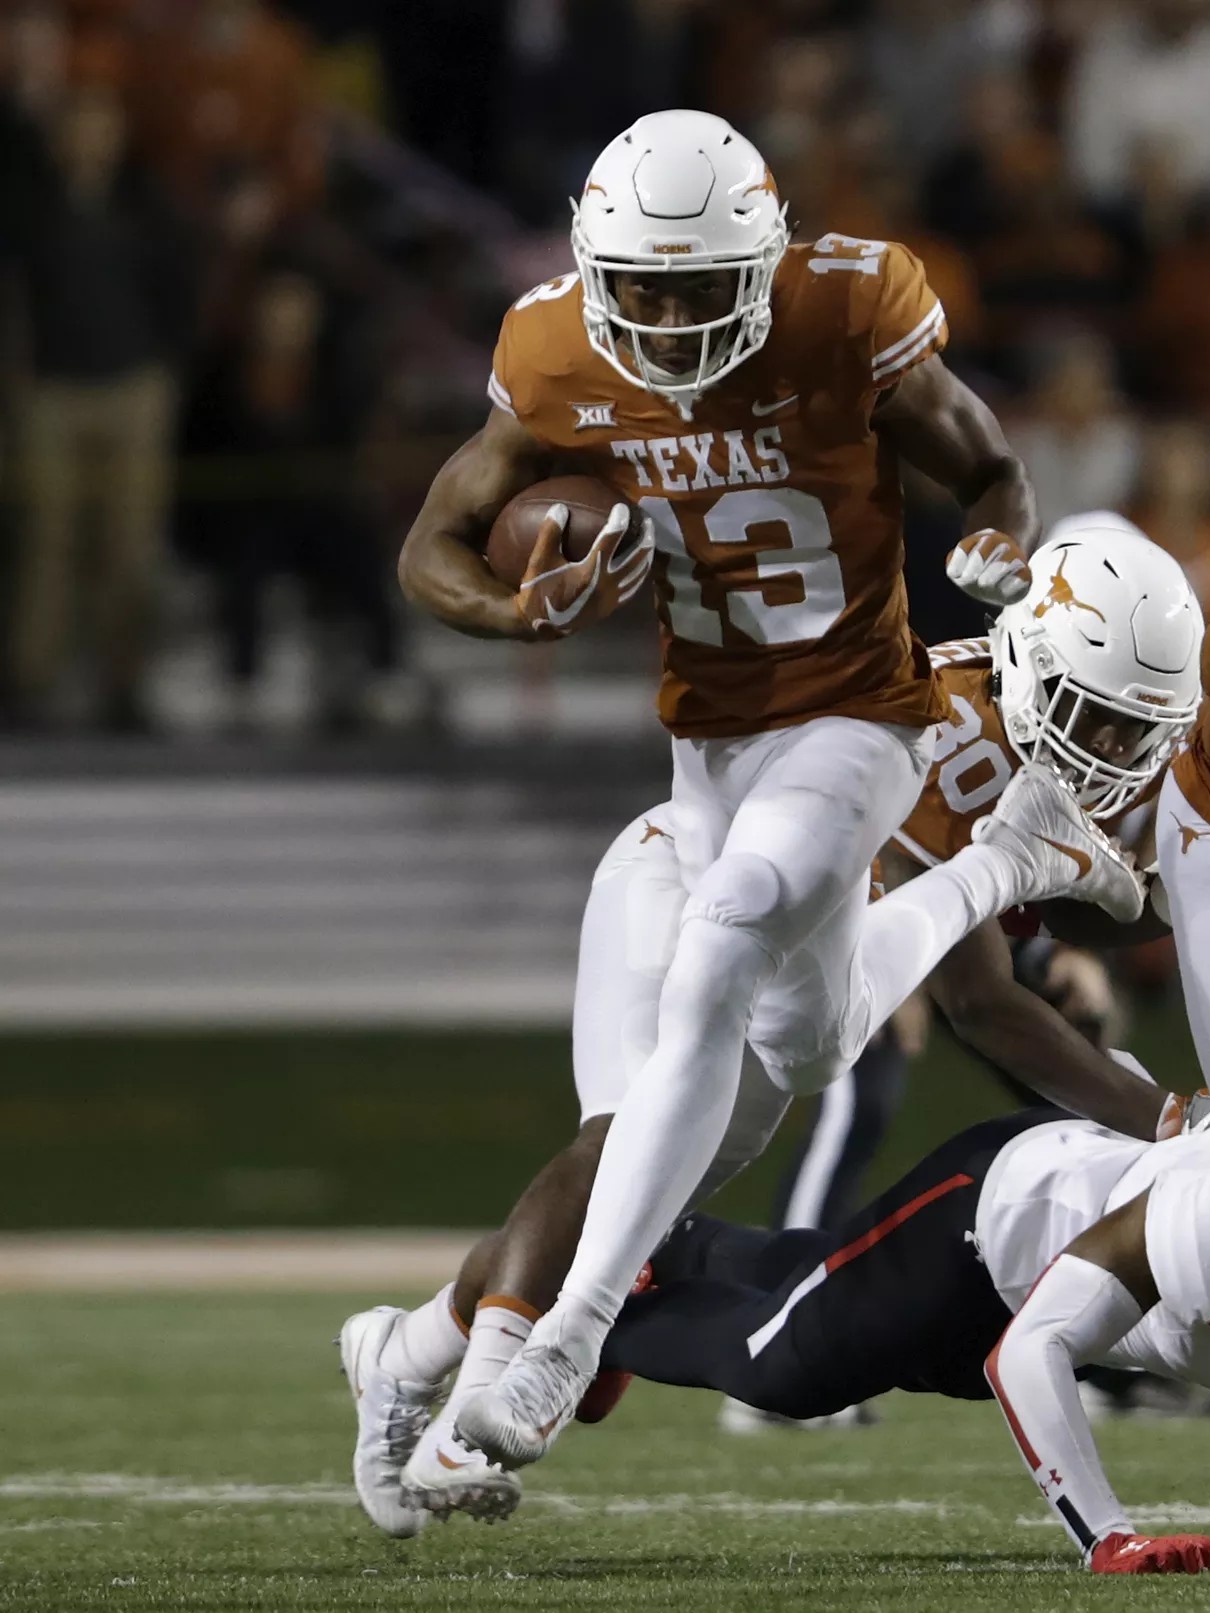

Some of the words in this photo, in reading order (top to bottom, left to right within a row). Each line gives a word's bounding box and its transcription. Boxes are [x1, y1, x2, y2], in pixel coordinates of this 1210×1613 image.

[652, 243, 692, 254] HORNS
[808, 232, 887, 274] 13
[610, 426, 791, 491] TEXAS
[638, 487, 847, 648] 13
